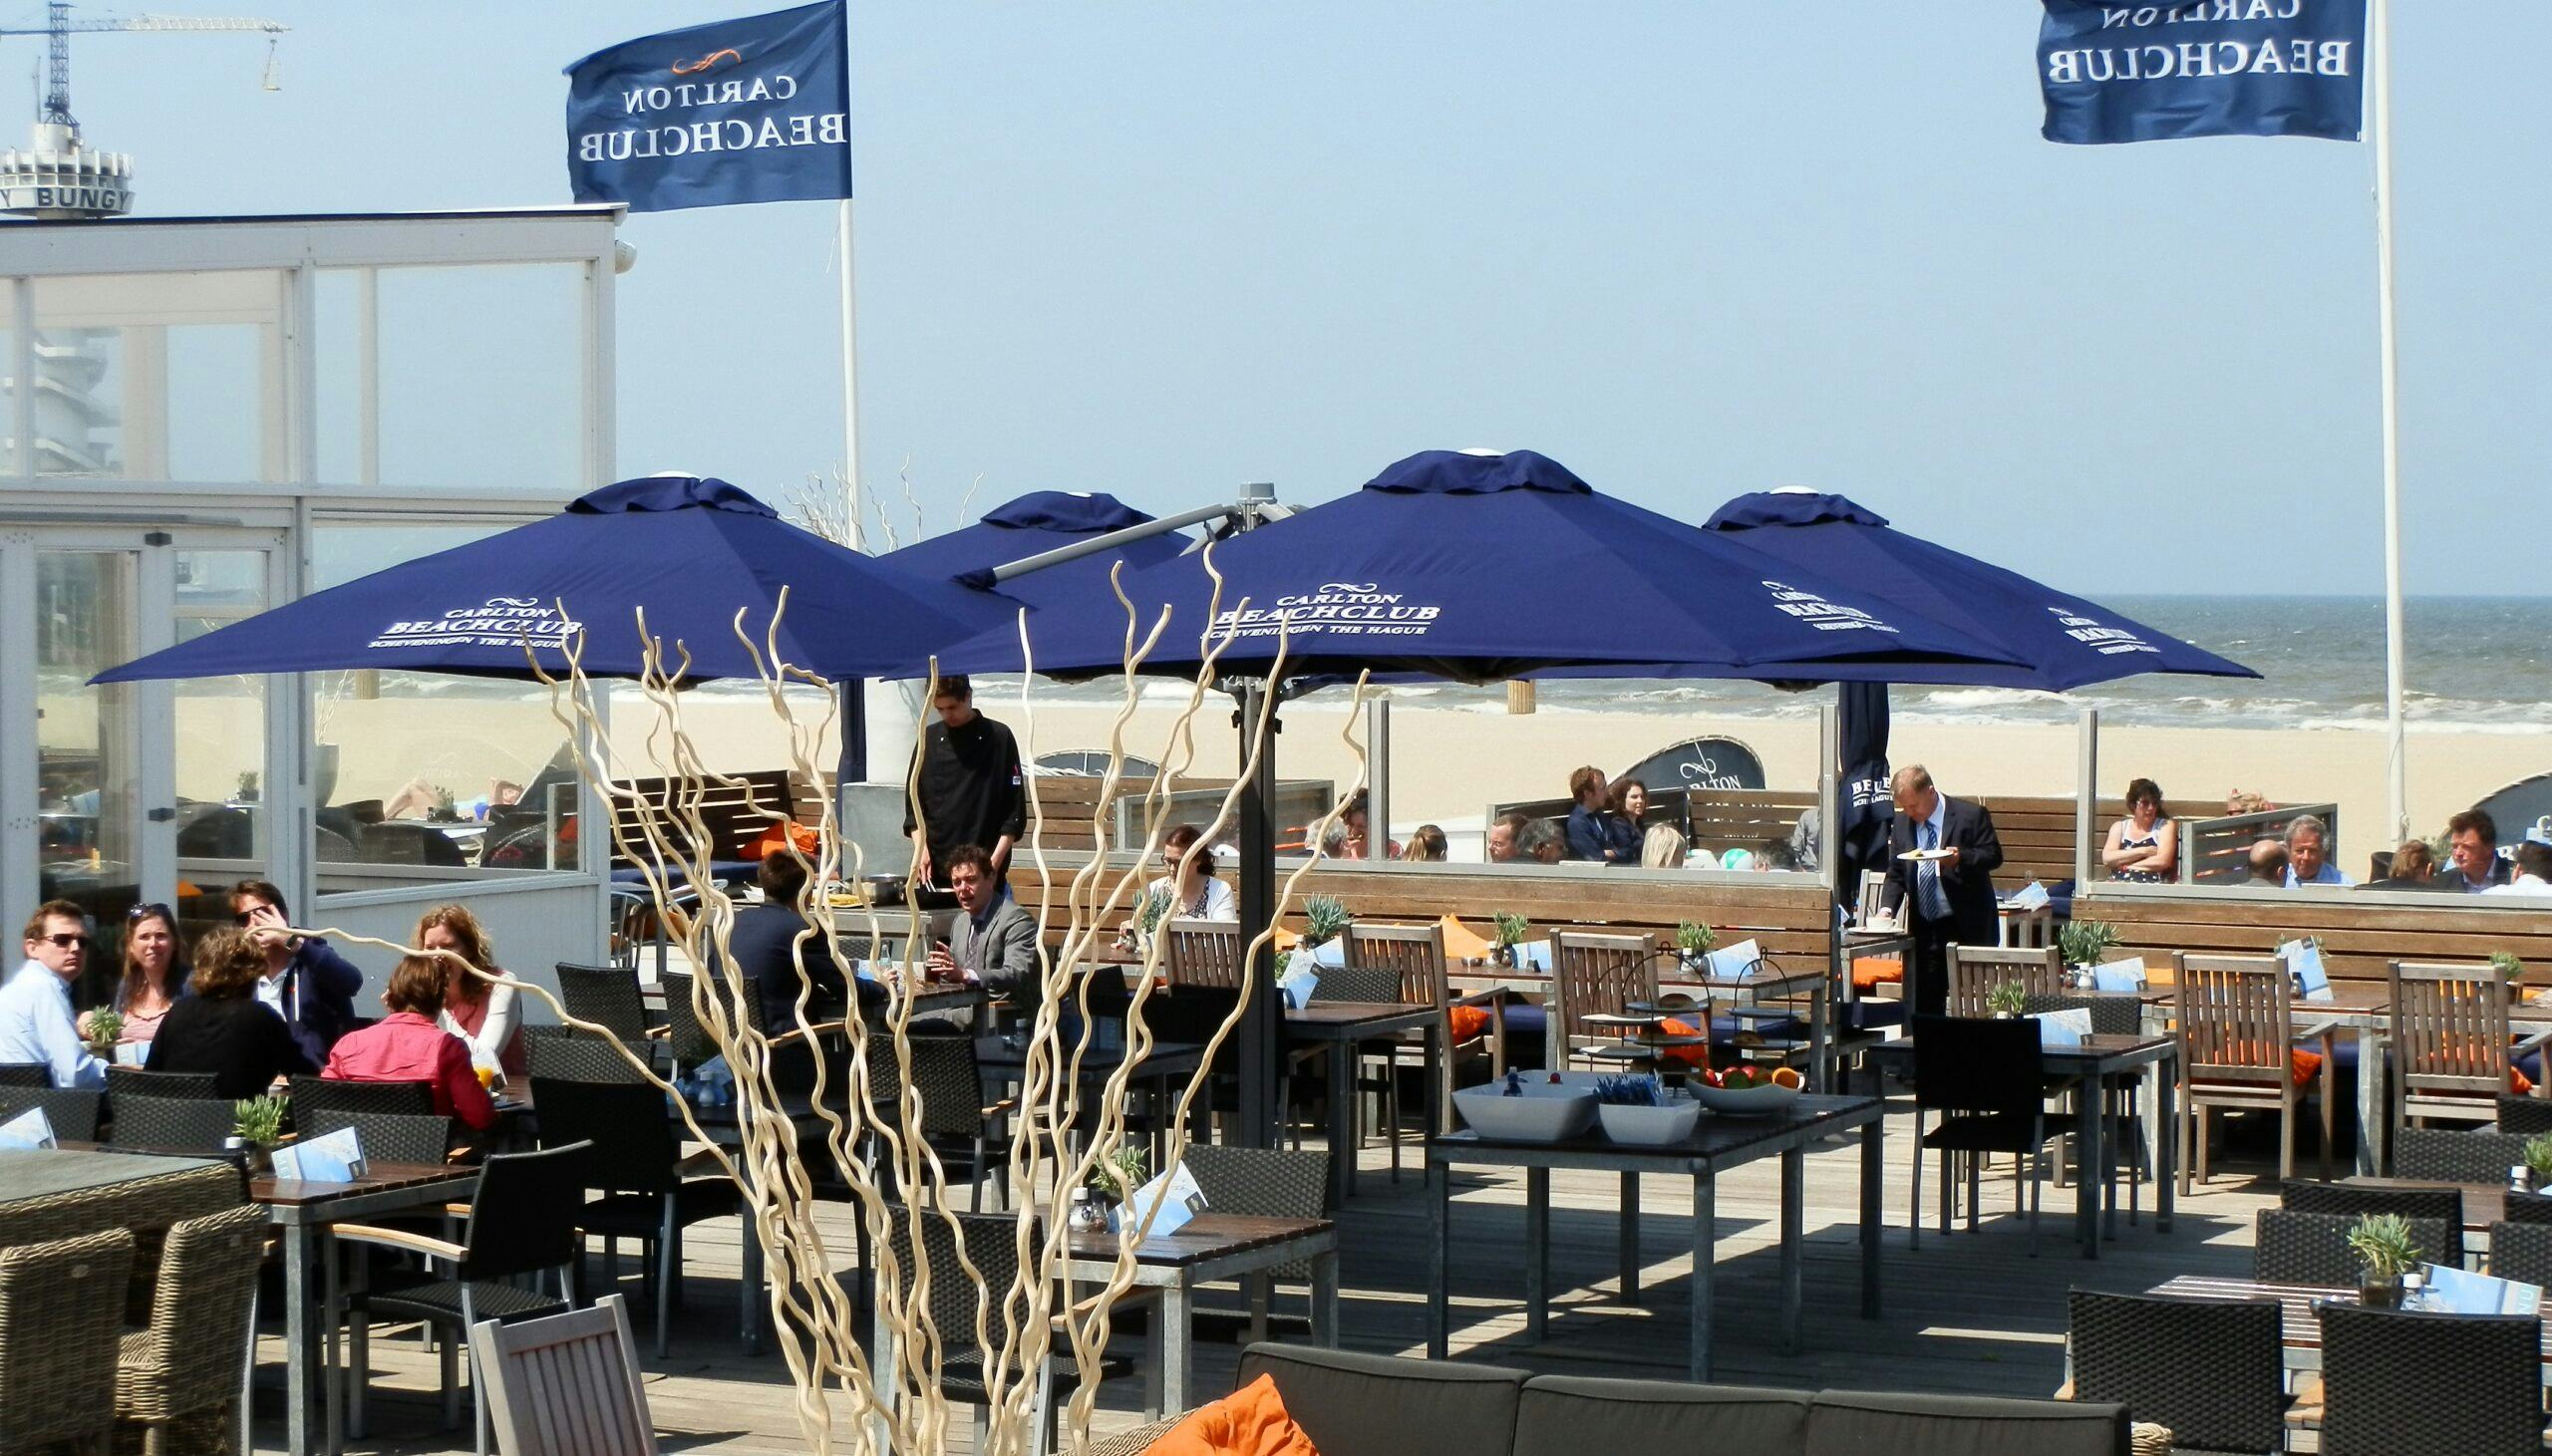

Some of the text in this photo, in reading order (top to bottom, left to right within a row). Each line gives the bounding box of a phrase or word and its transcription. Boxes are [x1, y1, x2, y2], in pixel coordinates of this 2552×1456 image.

[37, 187, 131, 210] BUNGY
[1276, 594, 1404, 606] CARLTON
[446, 607, 556, 619] CARLTON
[1214, 606, 1441, 624] BEACHCLUB
[385, 618, 583, 635] BEACHCLUB
[1329, 625, 1362, 635] THE
[1366, 626, 1428, 635] HAGUE
[368, 636, 475, 649] SCHEVENINGEN
[478, 637, 510, 647] THE
